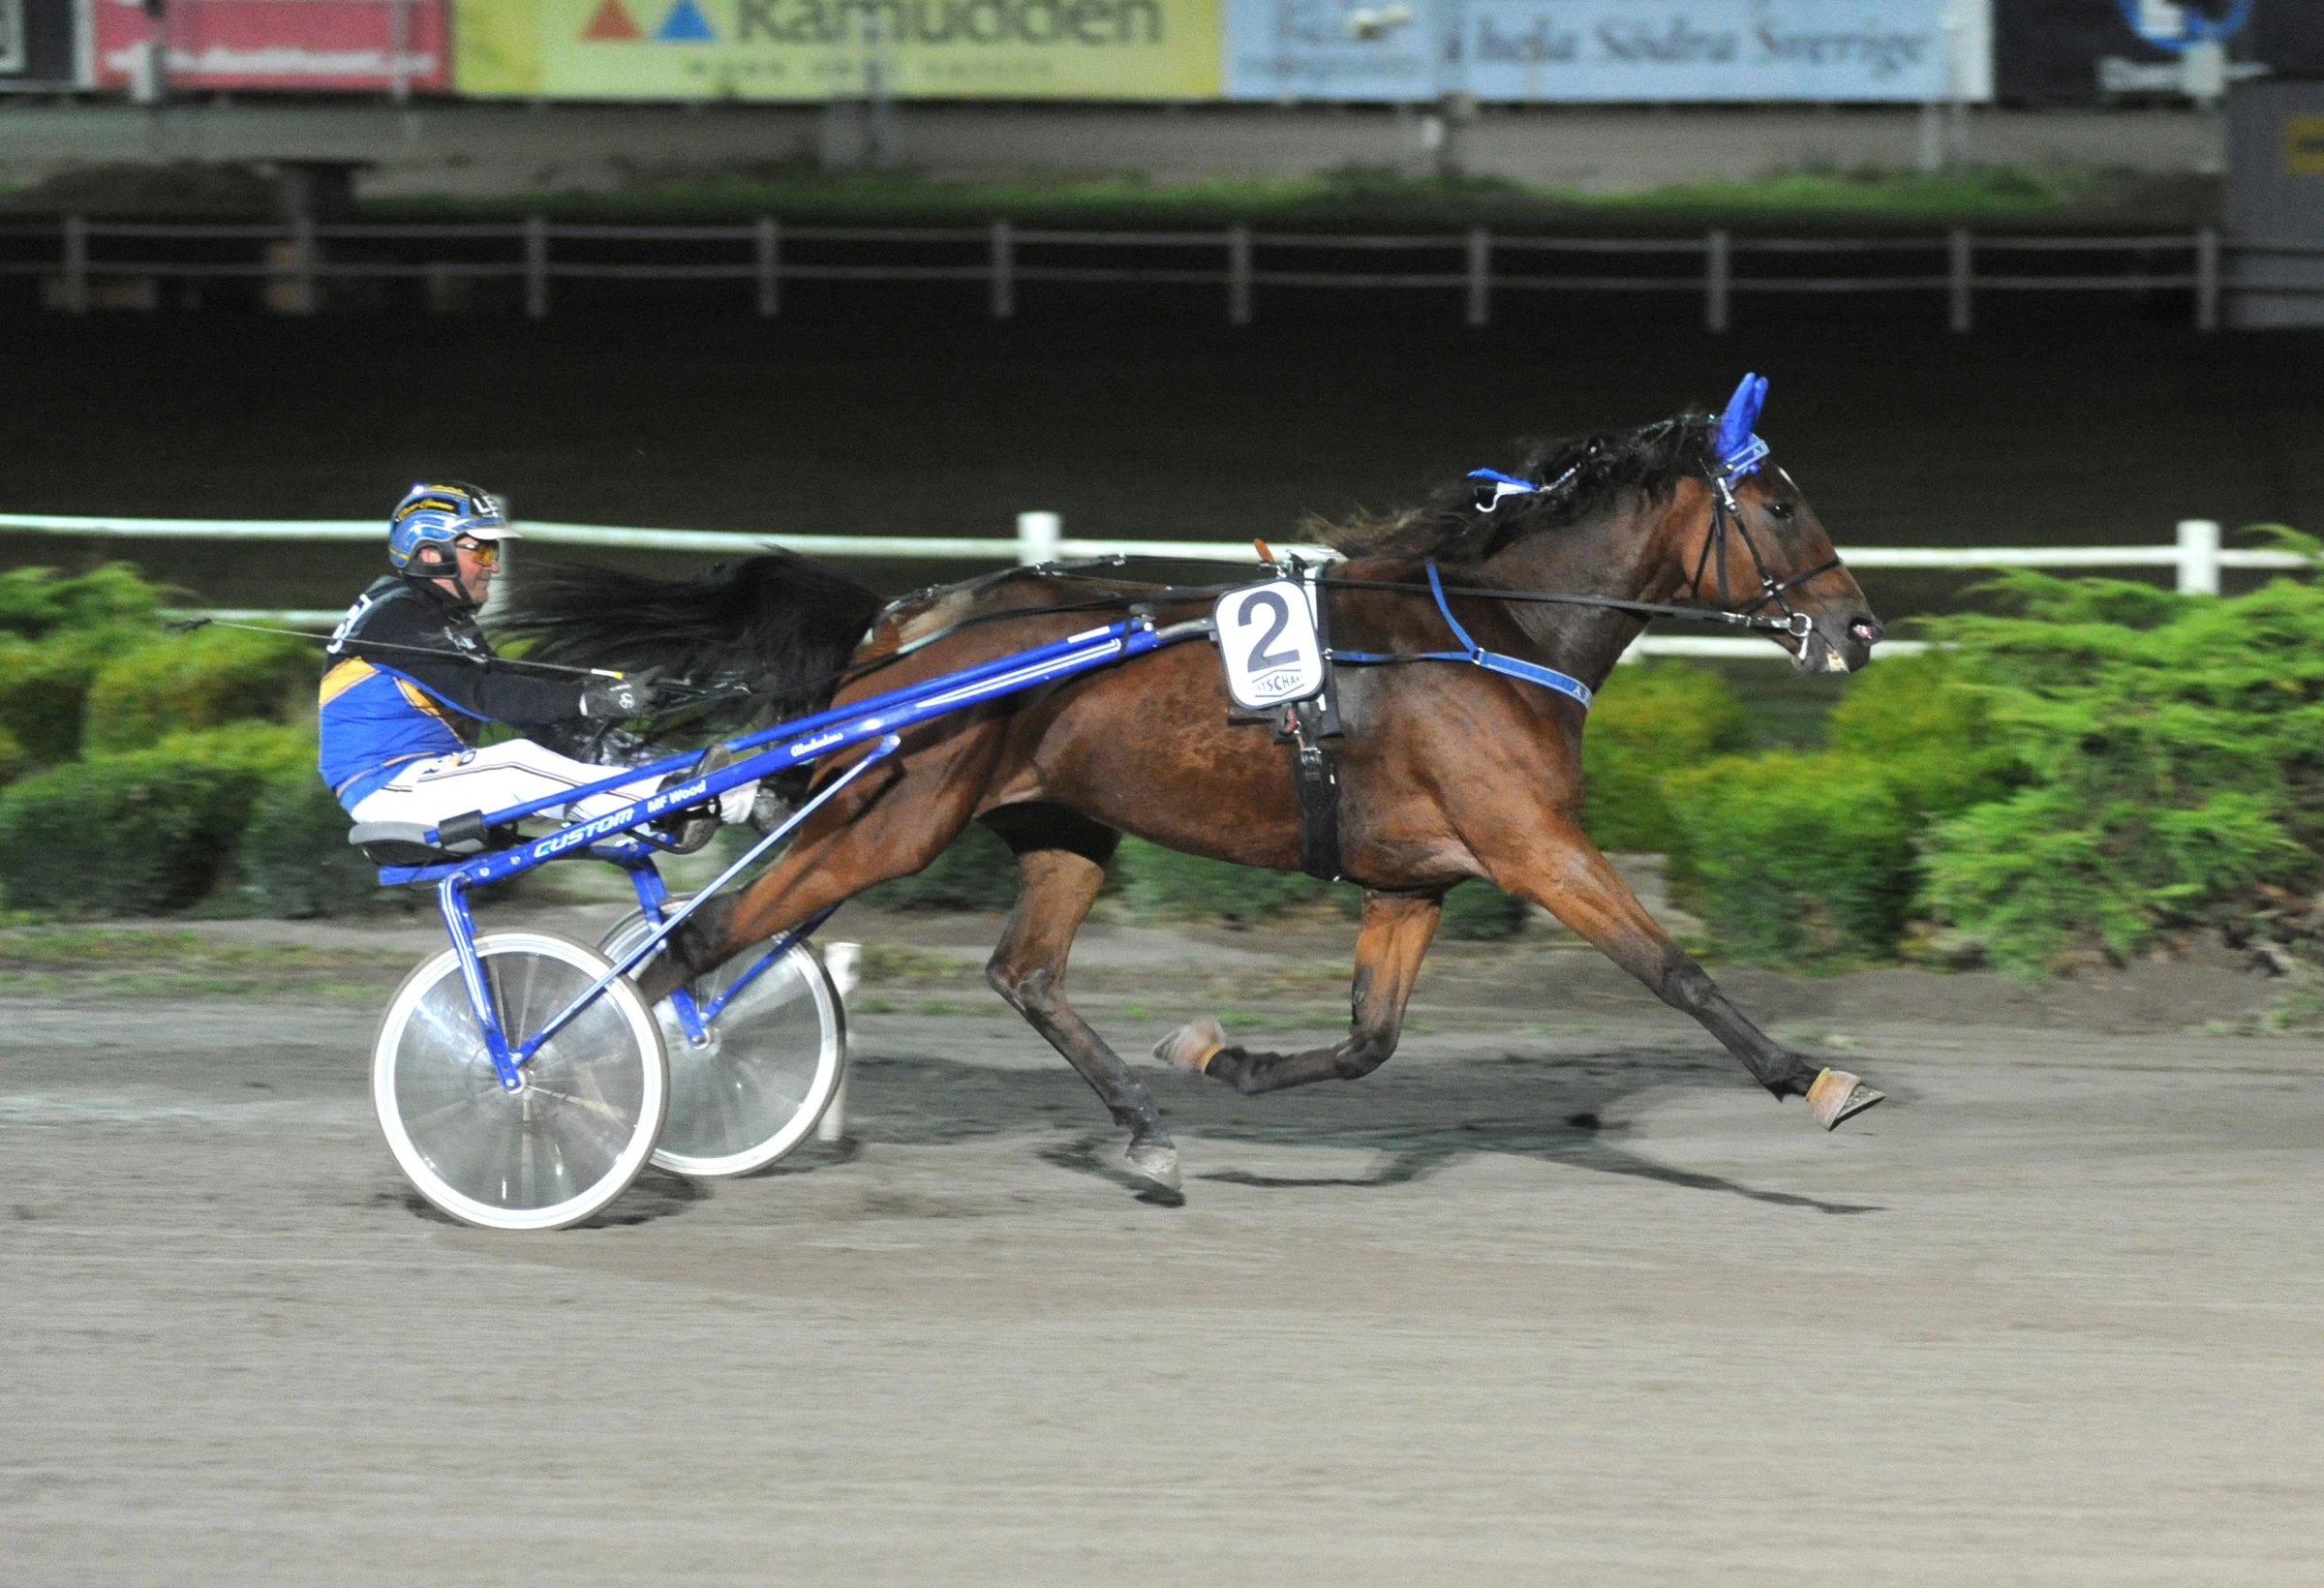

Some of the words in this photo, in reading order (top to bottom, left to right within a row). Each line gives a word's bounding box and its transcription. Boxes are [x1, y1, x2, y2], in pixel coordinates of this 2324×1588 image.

[739, 0, 1165, 45] Kamudden
[1238, 590, 1301, 673] 2
[534, 808, 634, 858] CUSTOM
[647, 796, 668, 813] MF
[669, 779, 707, 804] Wood
